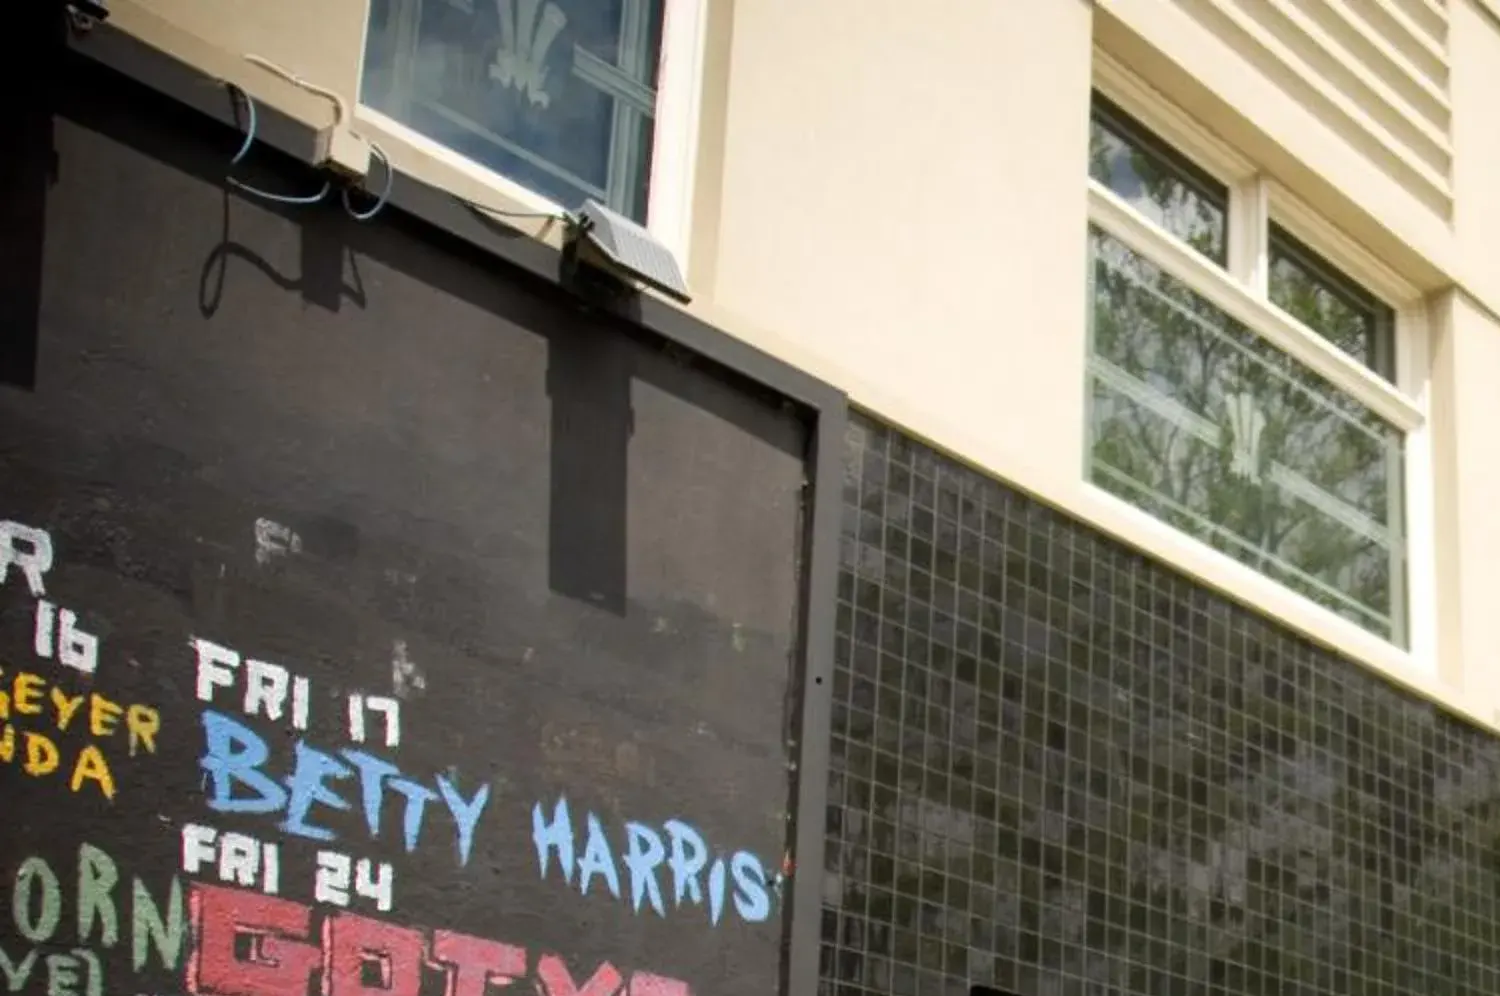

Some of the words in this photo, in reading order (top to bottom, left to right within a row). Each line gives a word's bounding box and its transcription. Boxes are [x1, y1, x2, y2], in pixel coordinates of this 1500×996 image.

[35, 599, 98, 674] 16
[0, 664, 161, 757] EYER
[190, 635, 309, 731] FRI
[349, 694, 399, 748] 17
[199, 708, 489, 868] BETTY
[532, 792, 770, 927] HARRIS
[182, 823, 280, 894] FRI
[315, 848, 393, 913] 24
